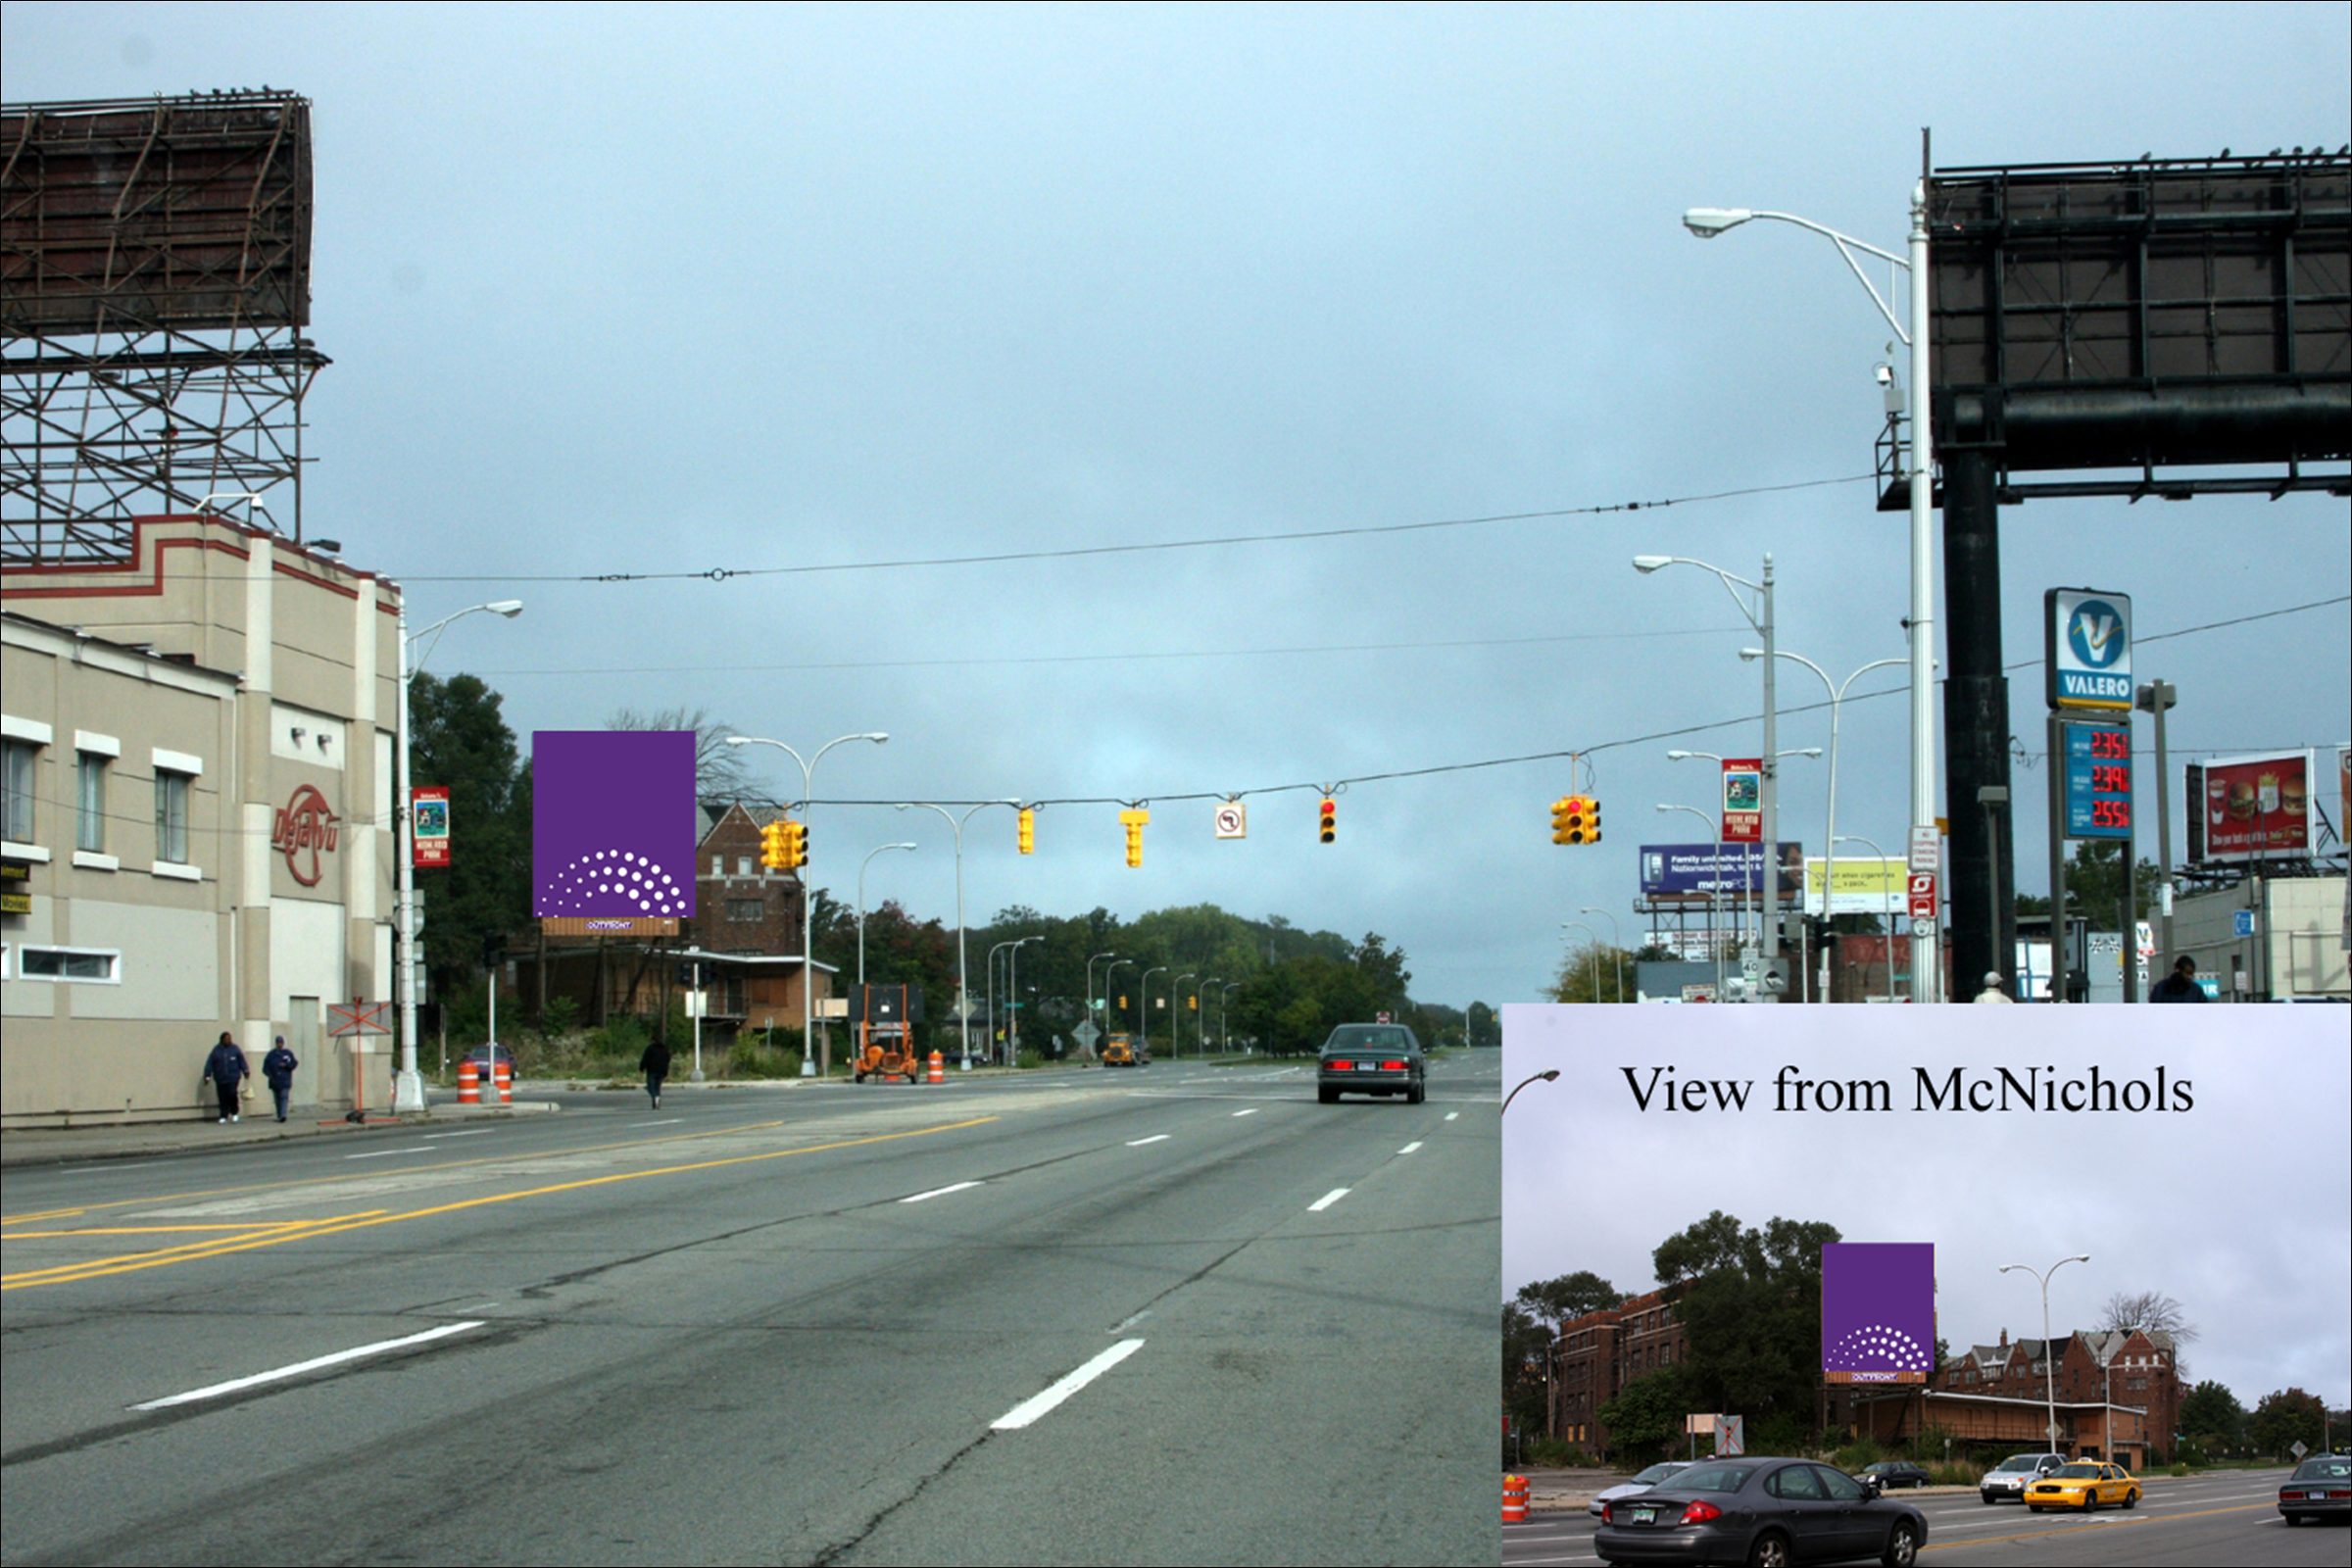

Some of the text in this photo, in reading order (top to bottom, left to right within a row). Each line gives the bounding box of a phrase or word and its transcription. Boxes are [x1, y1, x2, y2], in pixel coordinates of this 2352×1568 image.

[2065, 674, 2130, 697] VALERO
[1671, 856, 1700, 864] Family
[1743, 963, 1758, 972] 40
